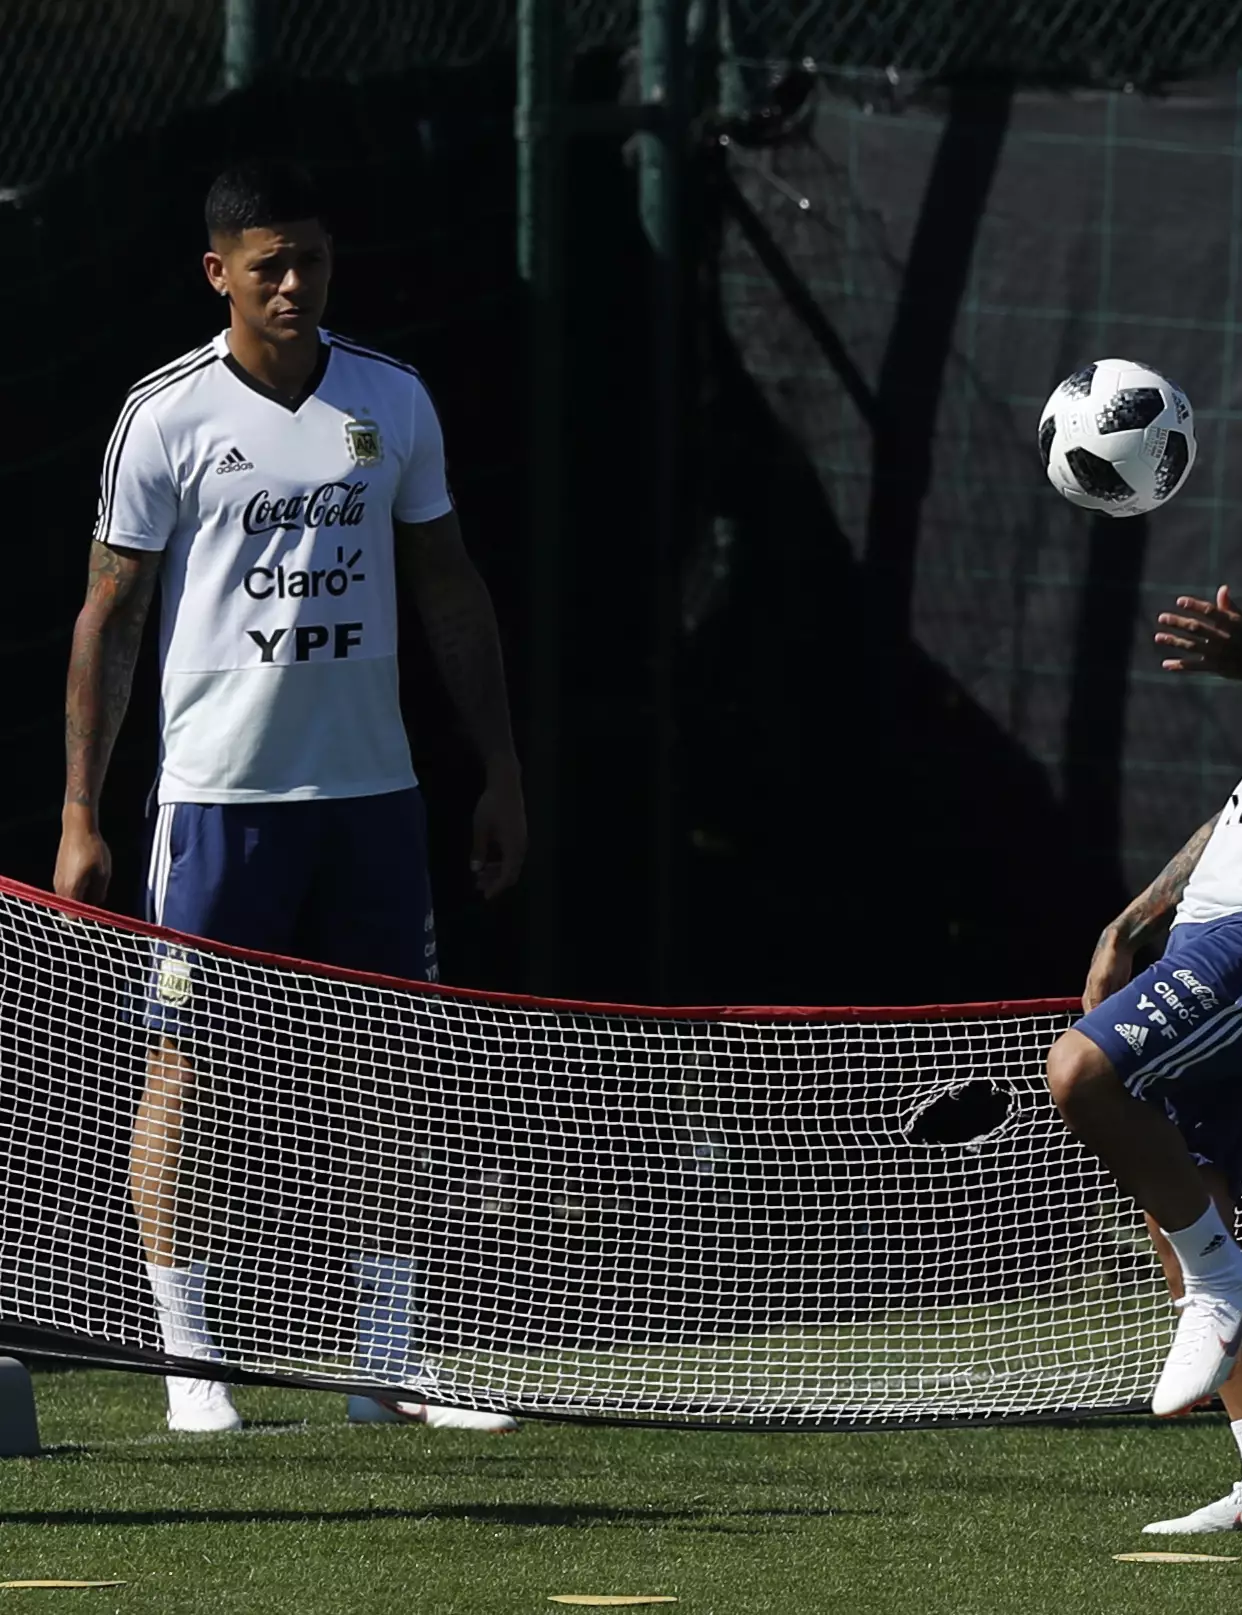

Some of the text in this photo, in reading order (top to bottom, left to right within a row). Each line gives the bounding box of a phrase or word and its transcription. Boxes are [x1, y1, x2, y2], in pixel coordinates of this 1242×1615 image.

[215, 462, 255, 475] adidas
[242, 480, 369, 536] Coca-Cola
[243, 564, 348, 601] Claro
[246, 622, 364, 663] YPF
[1135, 993, 1178, 1040] YPF
[1153, 980, 1190, 1021] Claro
